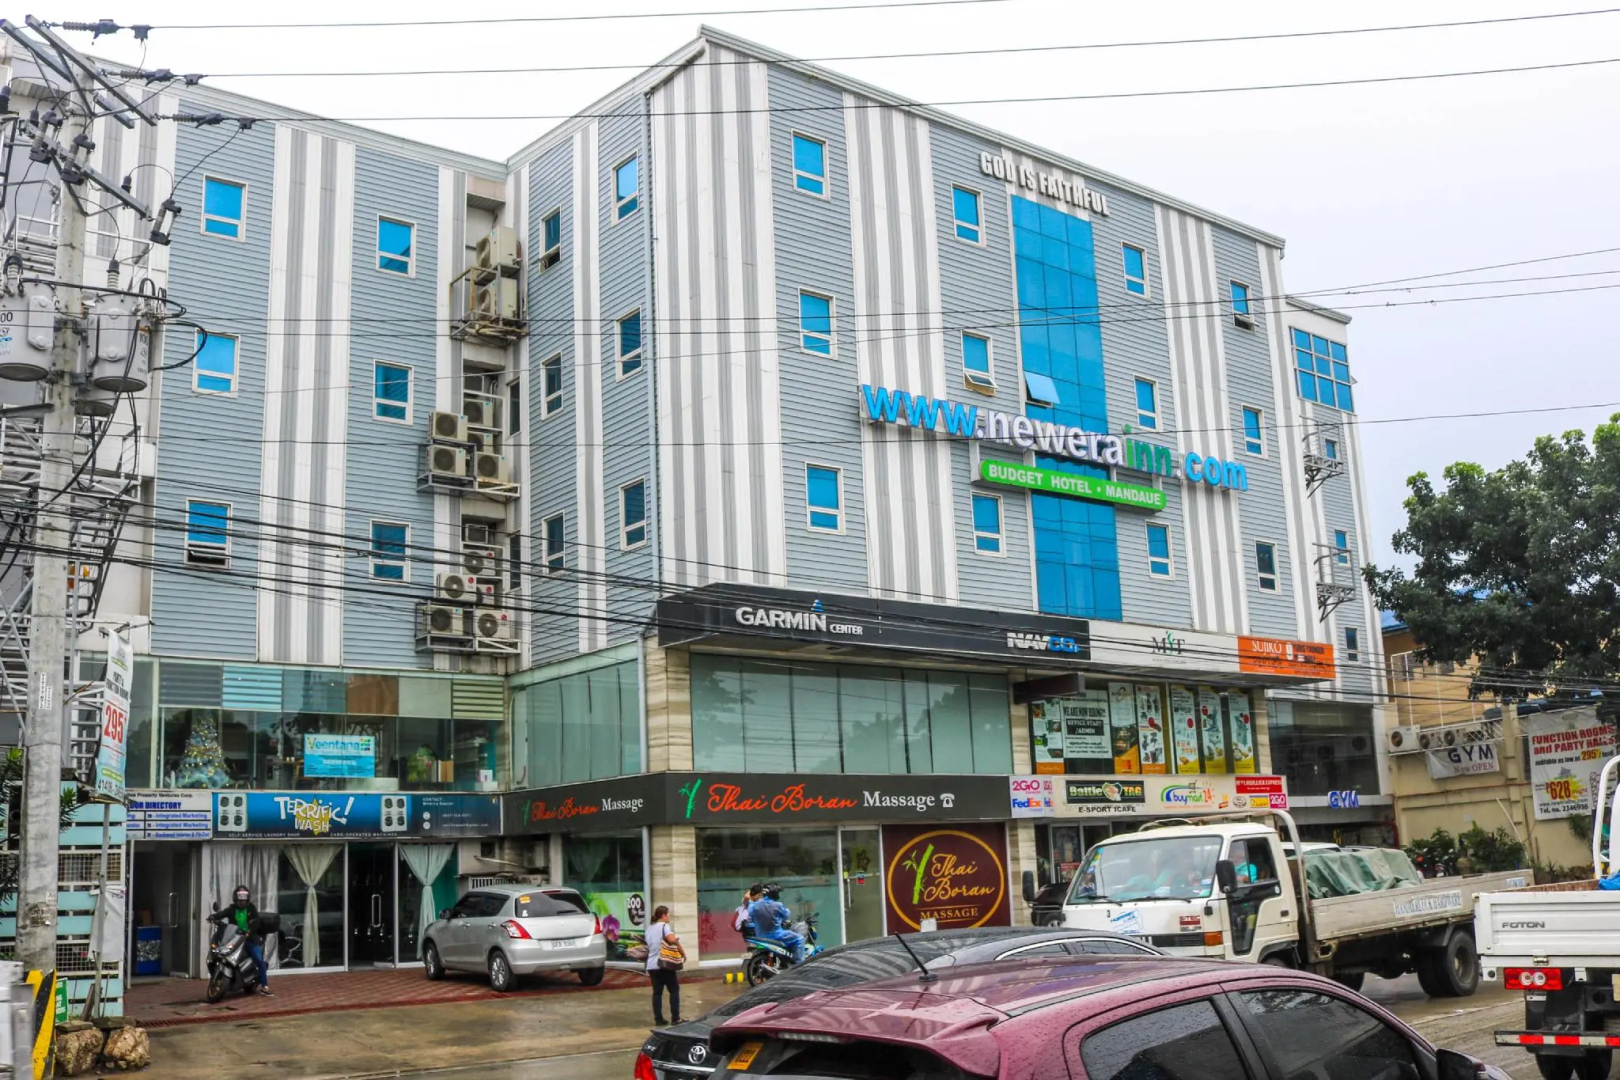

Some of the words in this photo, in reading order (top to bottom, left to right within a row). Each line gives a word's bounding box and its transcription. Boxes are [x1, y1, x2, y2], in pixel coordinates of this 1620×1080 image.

[980, 151, 1016, 183] GOD
[1018, 164, 1037, 191] IS
[1037, 171, 1110, 217] FAITHFUL
[988, 465, 1043, 487] BUDGET
[1051, 475, 1092, 494] HOTEL
[1105, 485, 1162, 506] MANDAUE
[736, 607, 827, 632] GARMIN
[829, 623, 863, 636] CENTER
[1531, 730, 1578, 745] FUNCTION
[1579, 724, 1616, 739] ROOMS
[1447, 744, 1494, 764] GYM
[1534, 744, 1552, 755] and
[1554, 740, 1584, 753] PARTY
[1472, 762, 1494, 771] OPEN
[1012, 780, 1040, 791] 2GO
[1069, 786, 1103, 797] Battle
[1123, 786, 1142, 796] TAG
[145, 801, 182, 809] DIRECTORY
[707, 783, 769, 813] Thai
[771, 783, 858, 813] Boran
[863, 791, 935, 812] Massage
[1012, 797, 1042, 808] FedEx
[1271, 795, 1286, 804] 2GO
[1328, 790, 1360, 808] GYM
[531, 801, 557, 821] Thai
[558, 797, 599, 819] Boran
[602, 798, 643, 813] Massage
[294, 817, 330, 832] WASH
[931, 853, 978, 877] Thai
[924, 875, 995, 902] Boran
[626, 897, 641, 909] 200
[920, 908, 979, 920] MASSAGE
[1502, 921, 1546, 929] FOTON
